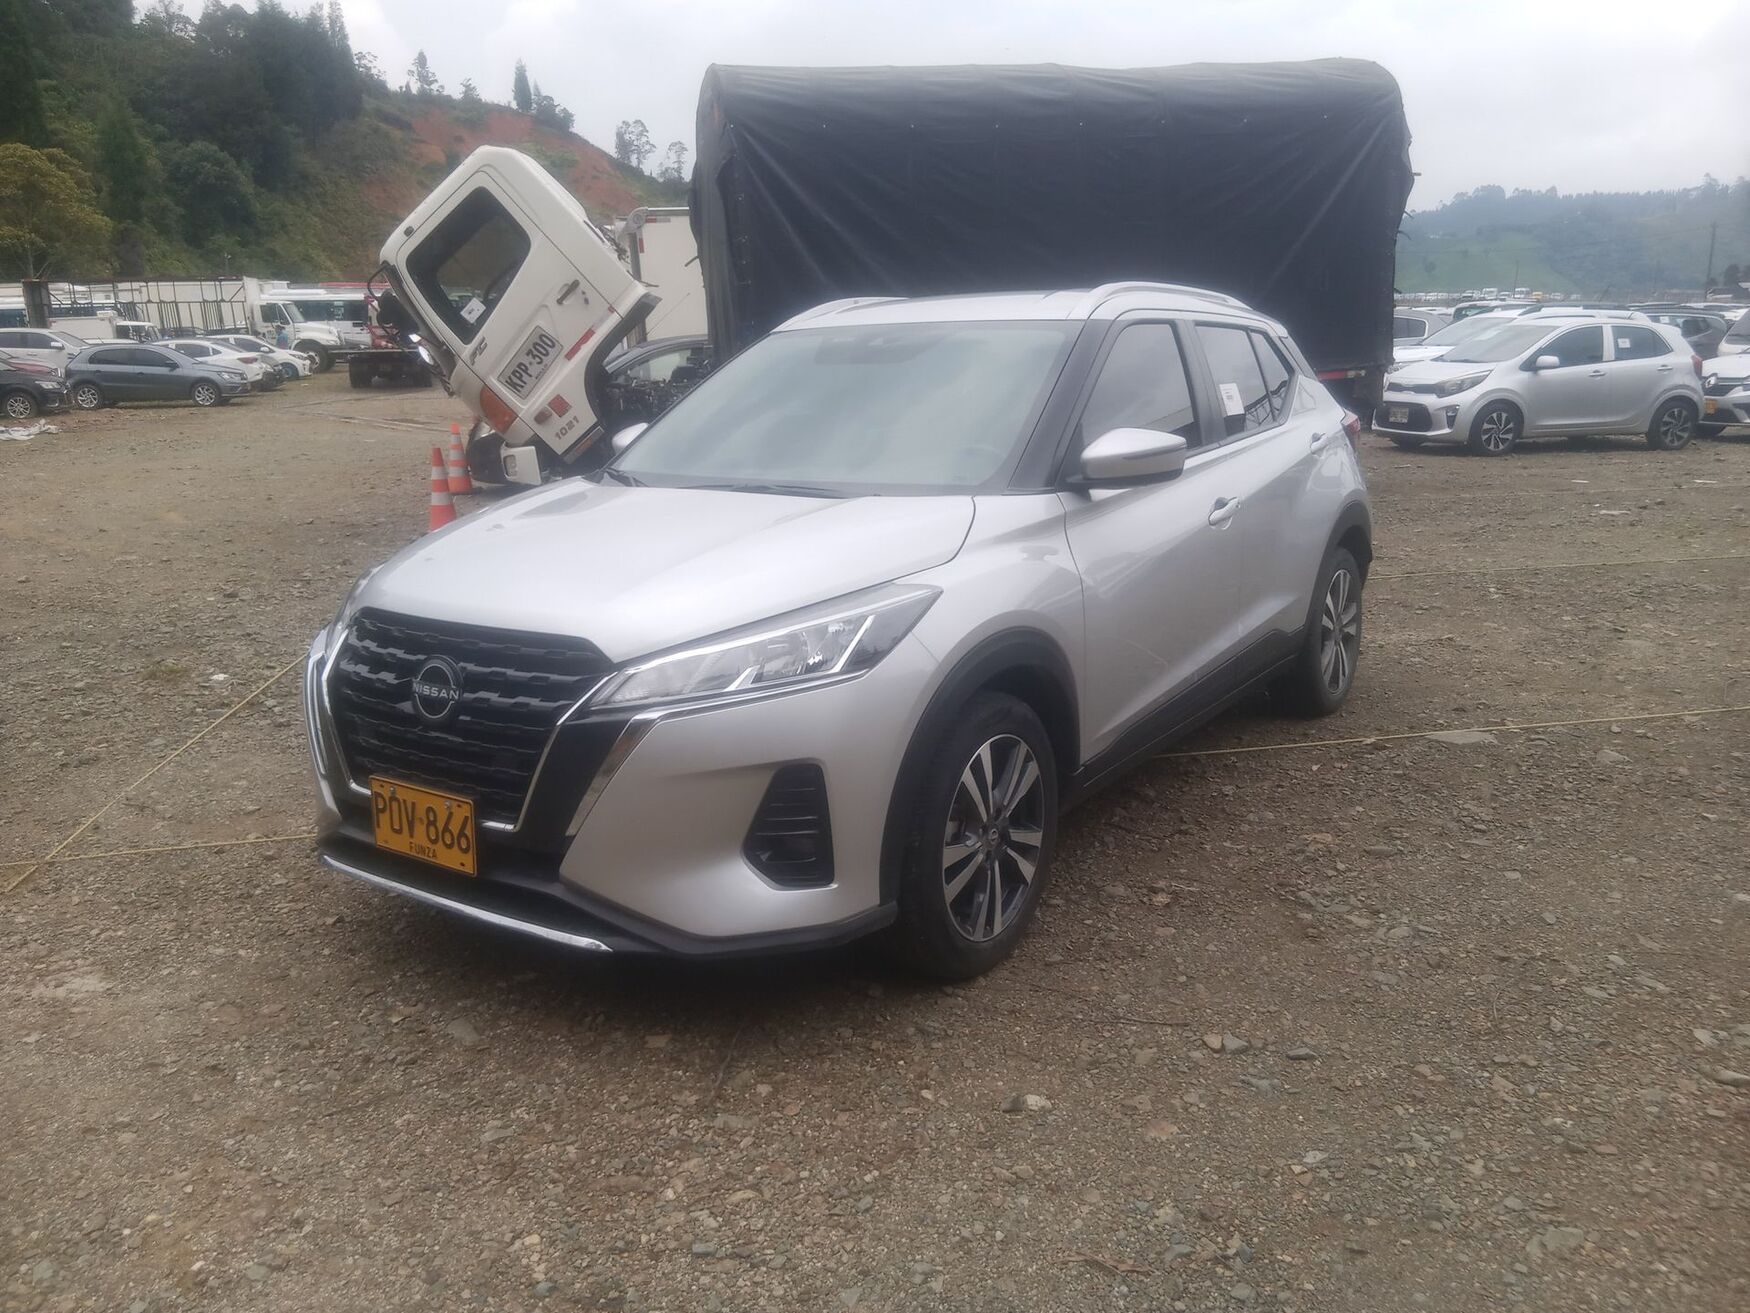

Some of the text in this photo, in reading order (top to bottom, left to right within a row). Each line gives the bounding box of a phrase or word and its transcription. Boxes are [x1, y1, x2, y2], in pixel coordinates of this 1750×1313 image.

[555, 415, 580, 440] 1021
[412, 681, 459, 700] NISSAN
[408, 841, 437, 858] FUNZA
